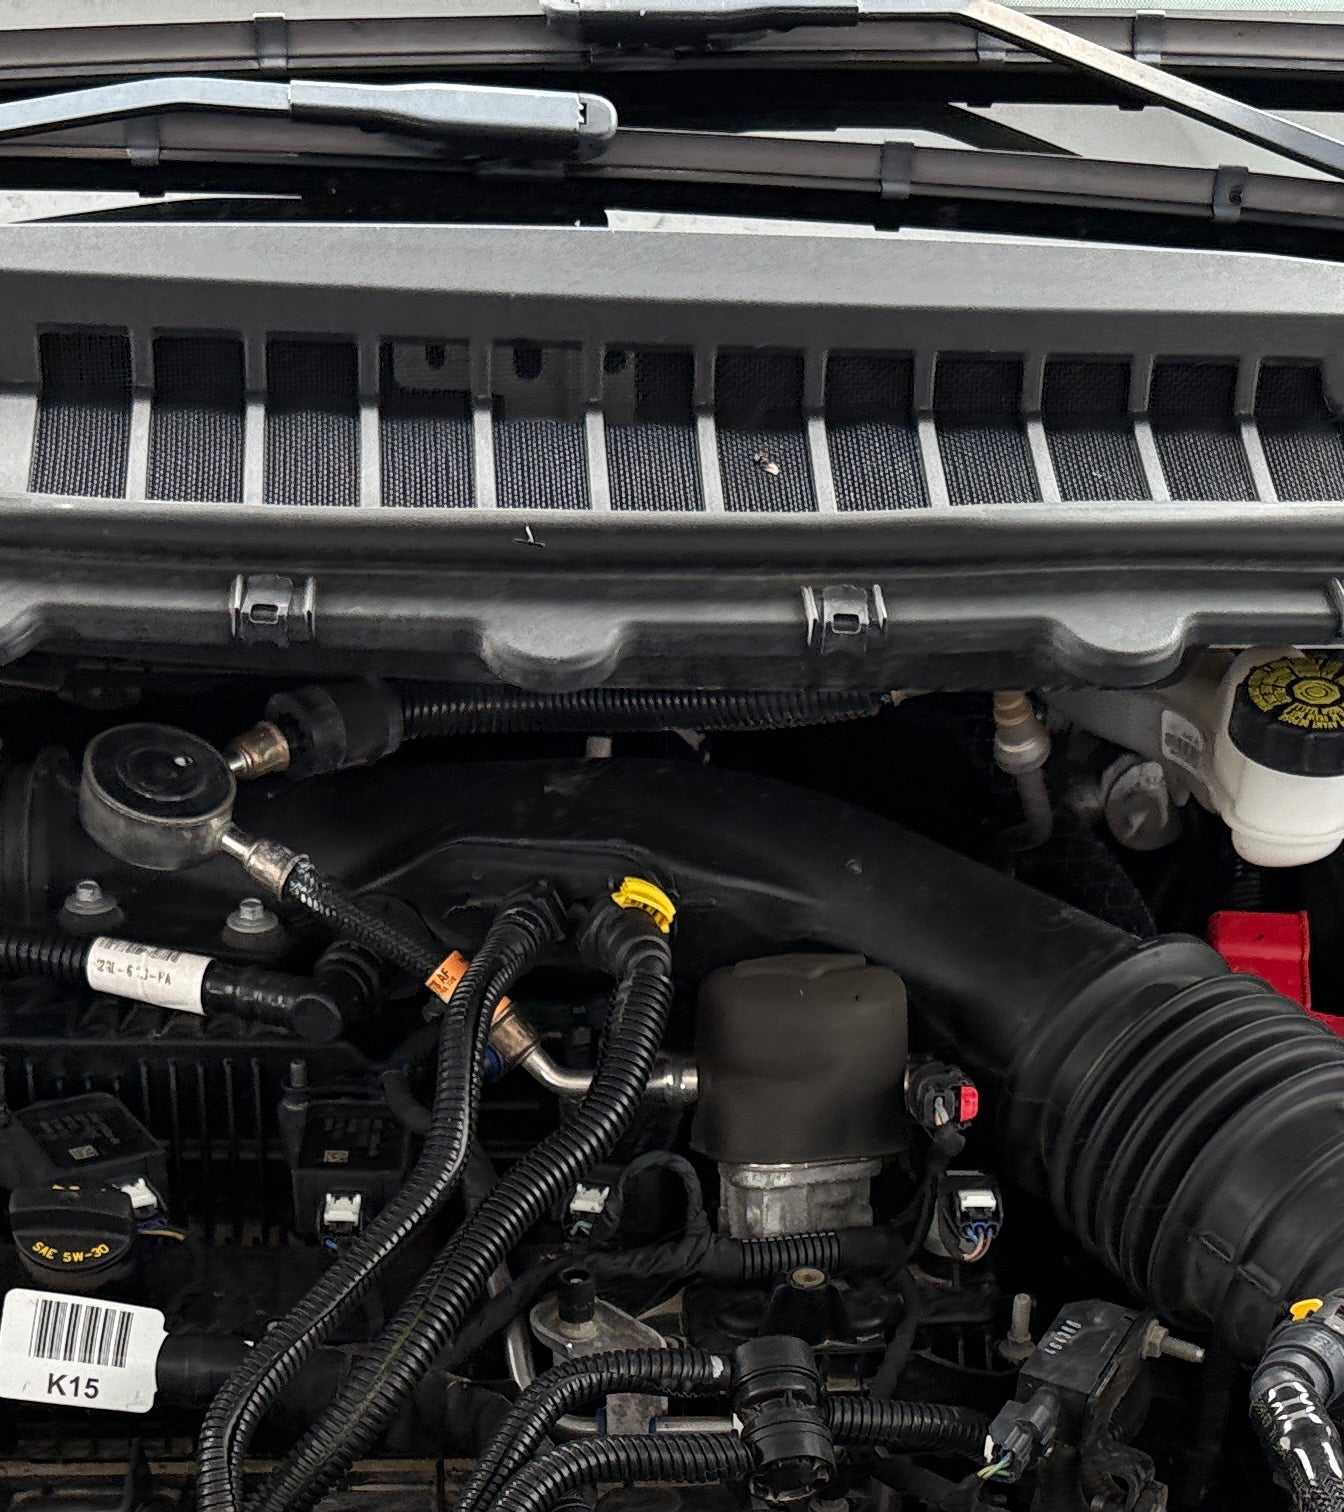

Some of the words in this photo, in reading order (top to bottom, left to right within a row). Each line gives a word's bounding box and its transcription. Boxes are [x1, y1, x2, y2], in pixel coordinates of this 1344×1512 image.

[32, 1241, 58, 1259] SAE
[62, 1243, 110, 1263] 5W-30
[47, 1373, 99, 1399] K15
